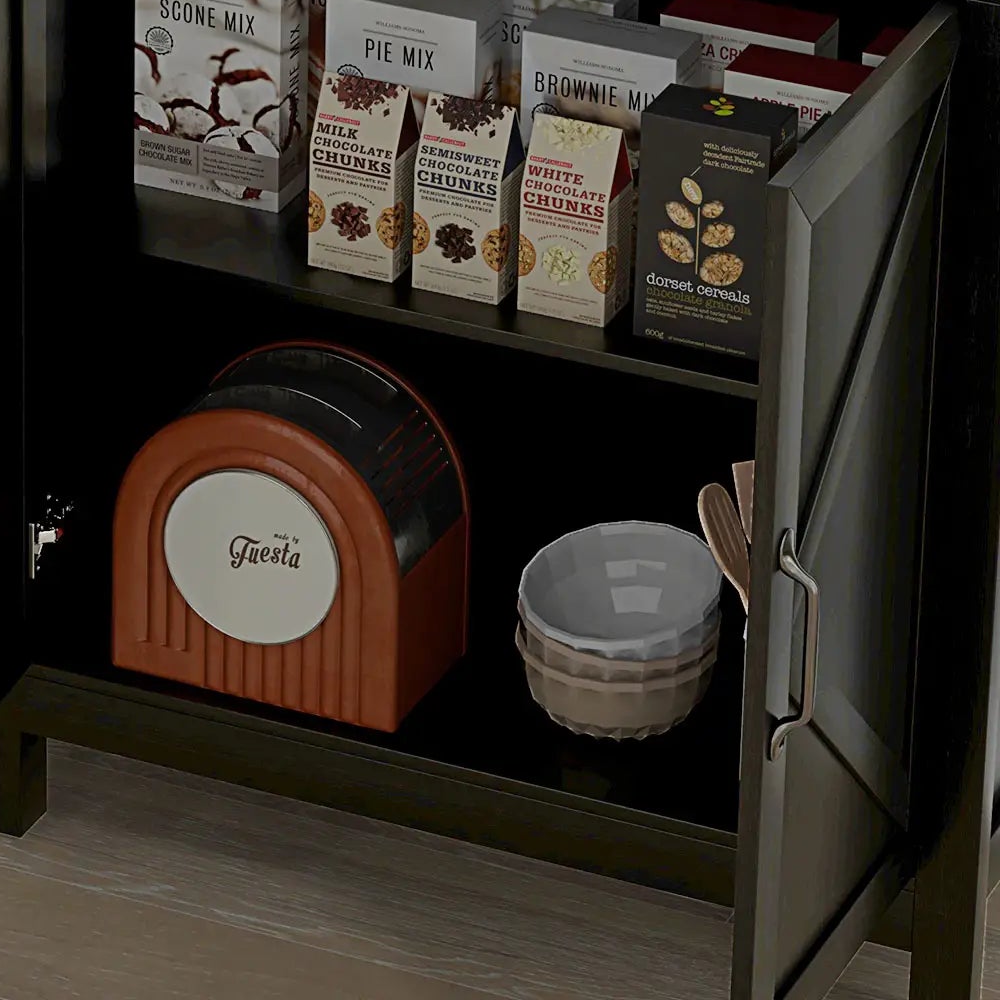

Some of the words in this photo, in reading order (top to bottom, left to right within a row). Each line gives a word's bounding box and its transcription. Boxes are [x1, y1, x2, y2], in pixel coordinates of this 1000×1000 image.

[224, 11, 255, 36] MIX
[365, 38, 392, 63] PIE
[403, 46, 434, 71] MIX
[534, 71, 618, 107] BROWNIE
[800, 105, 822, 121] PIE
[316, 122, 358, 140] MILK
[139, 148, 178, 164] CHOCOLATE
[180, 157, 192, 166] MIX
[140, 140, 166, 152] BROWN
[167, 143, 191, 156] SUGAR
[314, 136, 393, 160] CHOCOLATE
[420, 145, 501, 169] SEMISWEET
[703, 142, 720, 151] with
[721, 145, 760, 159] deliciously
[312, 148, 391, 174] CHUNKS
[418, 157, 499, 181] CHOCOLATE
[702, 159, 720, 168] dark
[721, 162, 754, 174] chocolate
[734, 156, 766, 168] Fairtrade
[314, 167, 341, 177] PREMIUM
[343, 172, 376, 183] CHOCOLATE
[316, 174, 345, 184] DESSERTS
[417, 170, 497, 196] CHUNKS
[528, 164, 584, 186] WHITE
[419, 189, 446, 198] PREMIUM
[448, 193, 481, 205] CHOCOLATE
[525, 179, 606, 203] CHOCOLATE
[421, 195, 450, 206] DESSERTS
[523, 191, 604, 217] CHUNKS
[525, 211, 553, 220] PREMIUM
[554, 215, 588, 227] CHOCOLATE
[527, 217, 556, 227] DESSERTS
[646, 272, 694, 293] dorset
[697, 284, 750, 304] cereals
[646, 286, 703, 305] chocolate
[705, 299, 753, 316] granola
[645, 328, 664, 340] 600g
[292, 536, 299, 544] by
